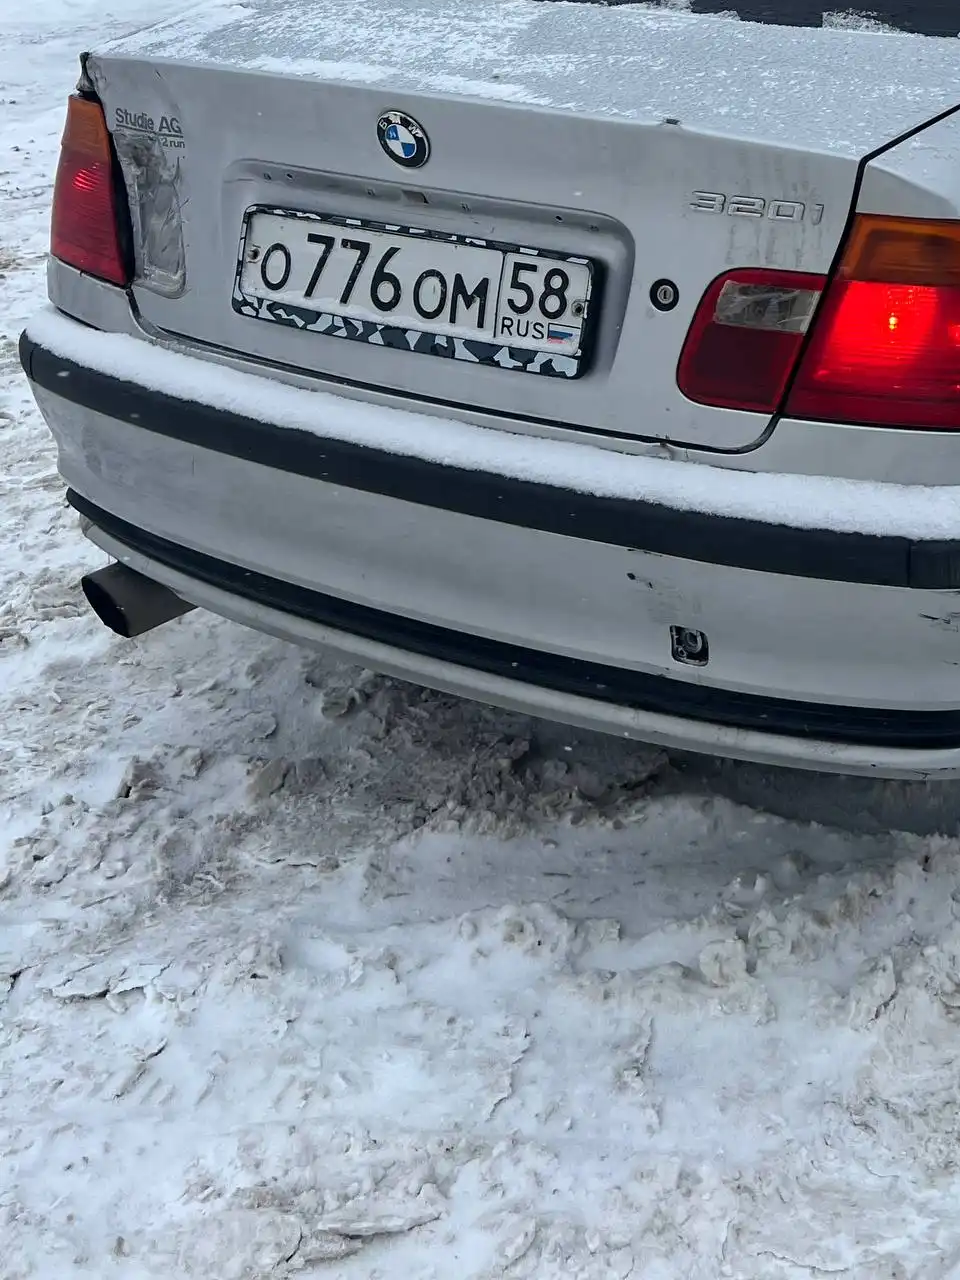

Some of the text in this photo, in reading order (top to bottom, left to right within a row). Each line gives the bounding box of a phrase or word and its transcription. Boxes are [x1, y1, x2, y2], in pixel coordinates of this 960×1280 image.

[115, 107, 184, 134] Studie AG
[689, 190, 824, 225] 320i
[506, 261, 570, 320] 58
[500, 316, 545, 340] RUS
